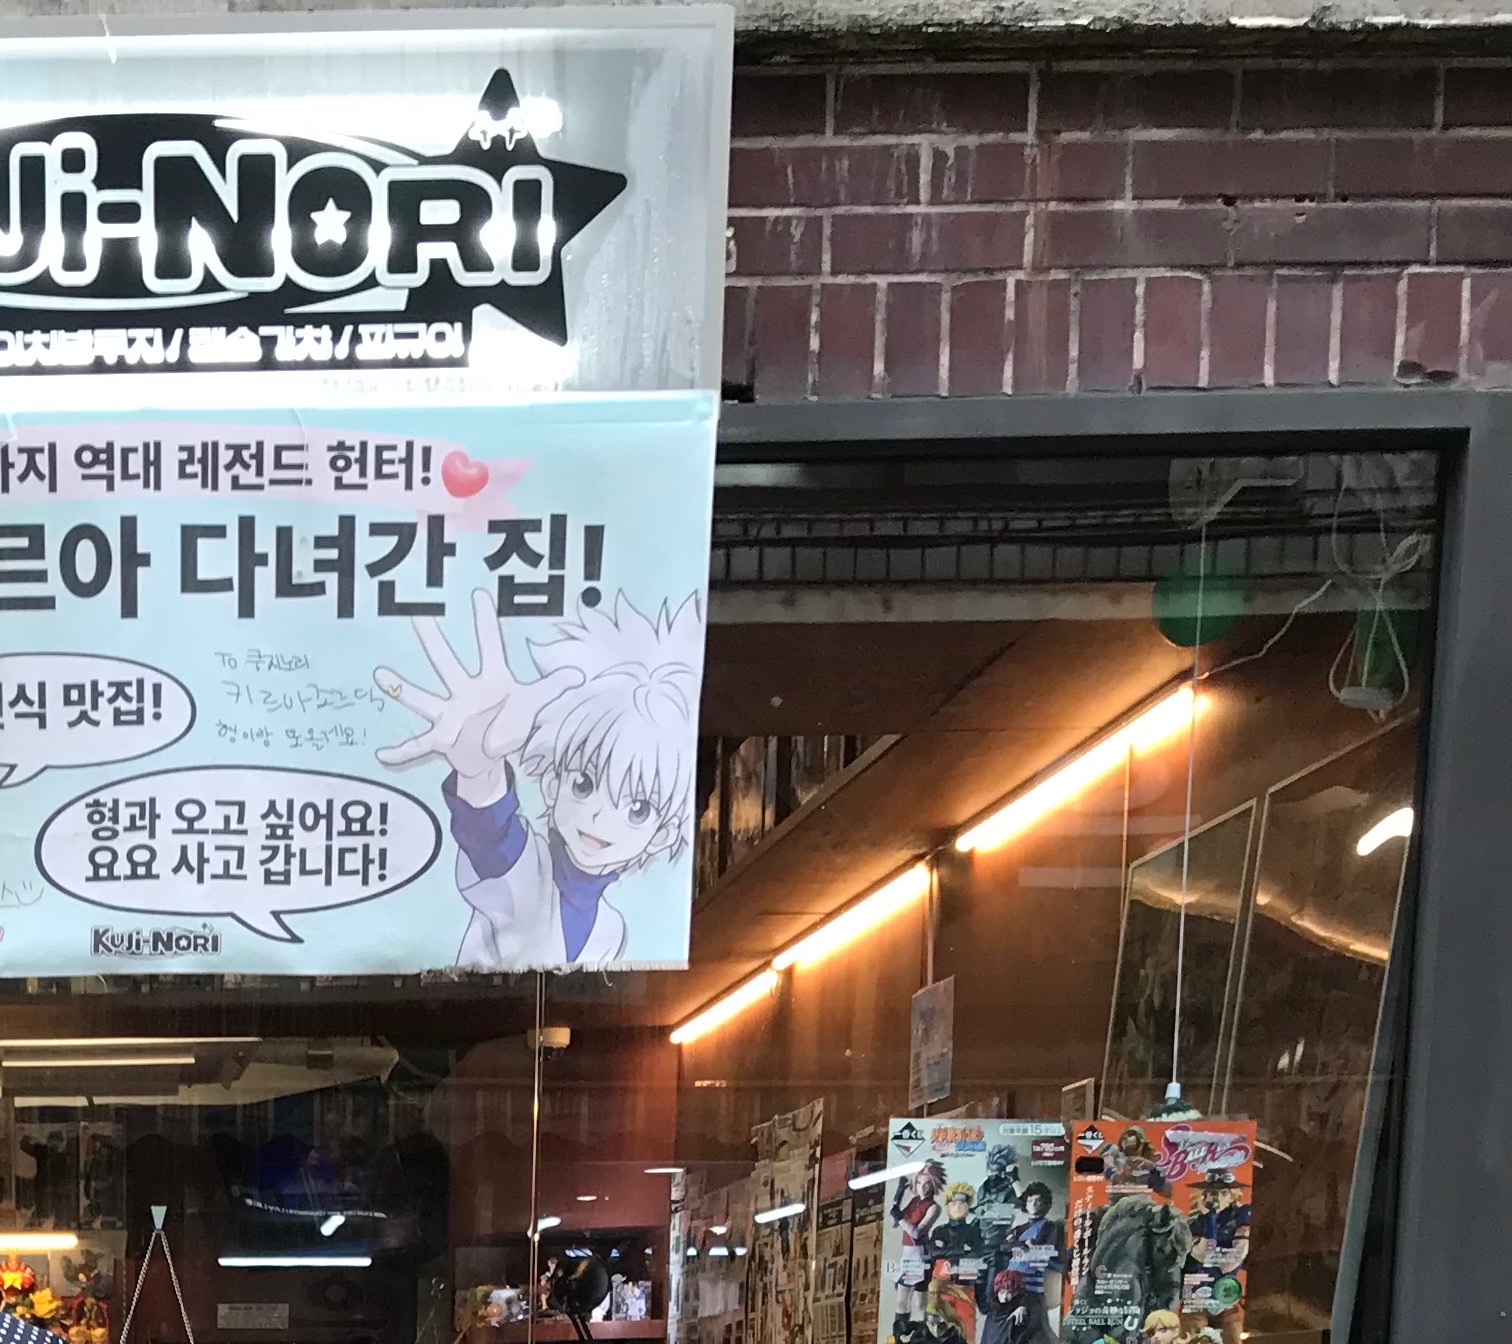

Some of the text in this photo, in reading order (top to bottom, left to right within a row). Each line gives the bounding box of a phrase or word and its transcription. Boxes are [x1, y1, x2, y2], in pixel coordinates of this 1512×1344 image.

[74, 441, 161, 492] 역대
[178, 441, 313, 490] 레전드
[327, 441, 432, 490] 헌터!
[181, 515, 456, 618] 다녀간
[484, 514, 604, 617] 집!
[63, 679, 164, 728] 맛집!
[84, 796, 390, 841] 형과 오고 싶어요!
[85, 842, 390, 887] 요요 사고 갑니다!
